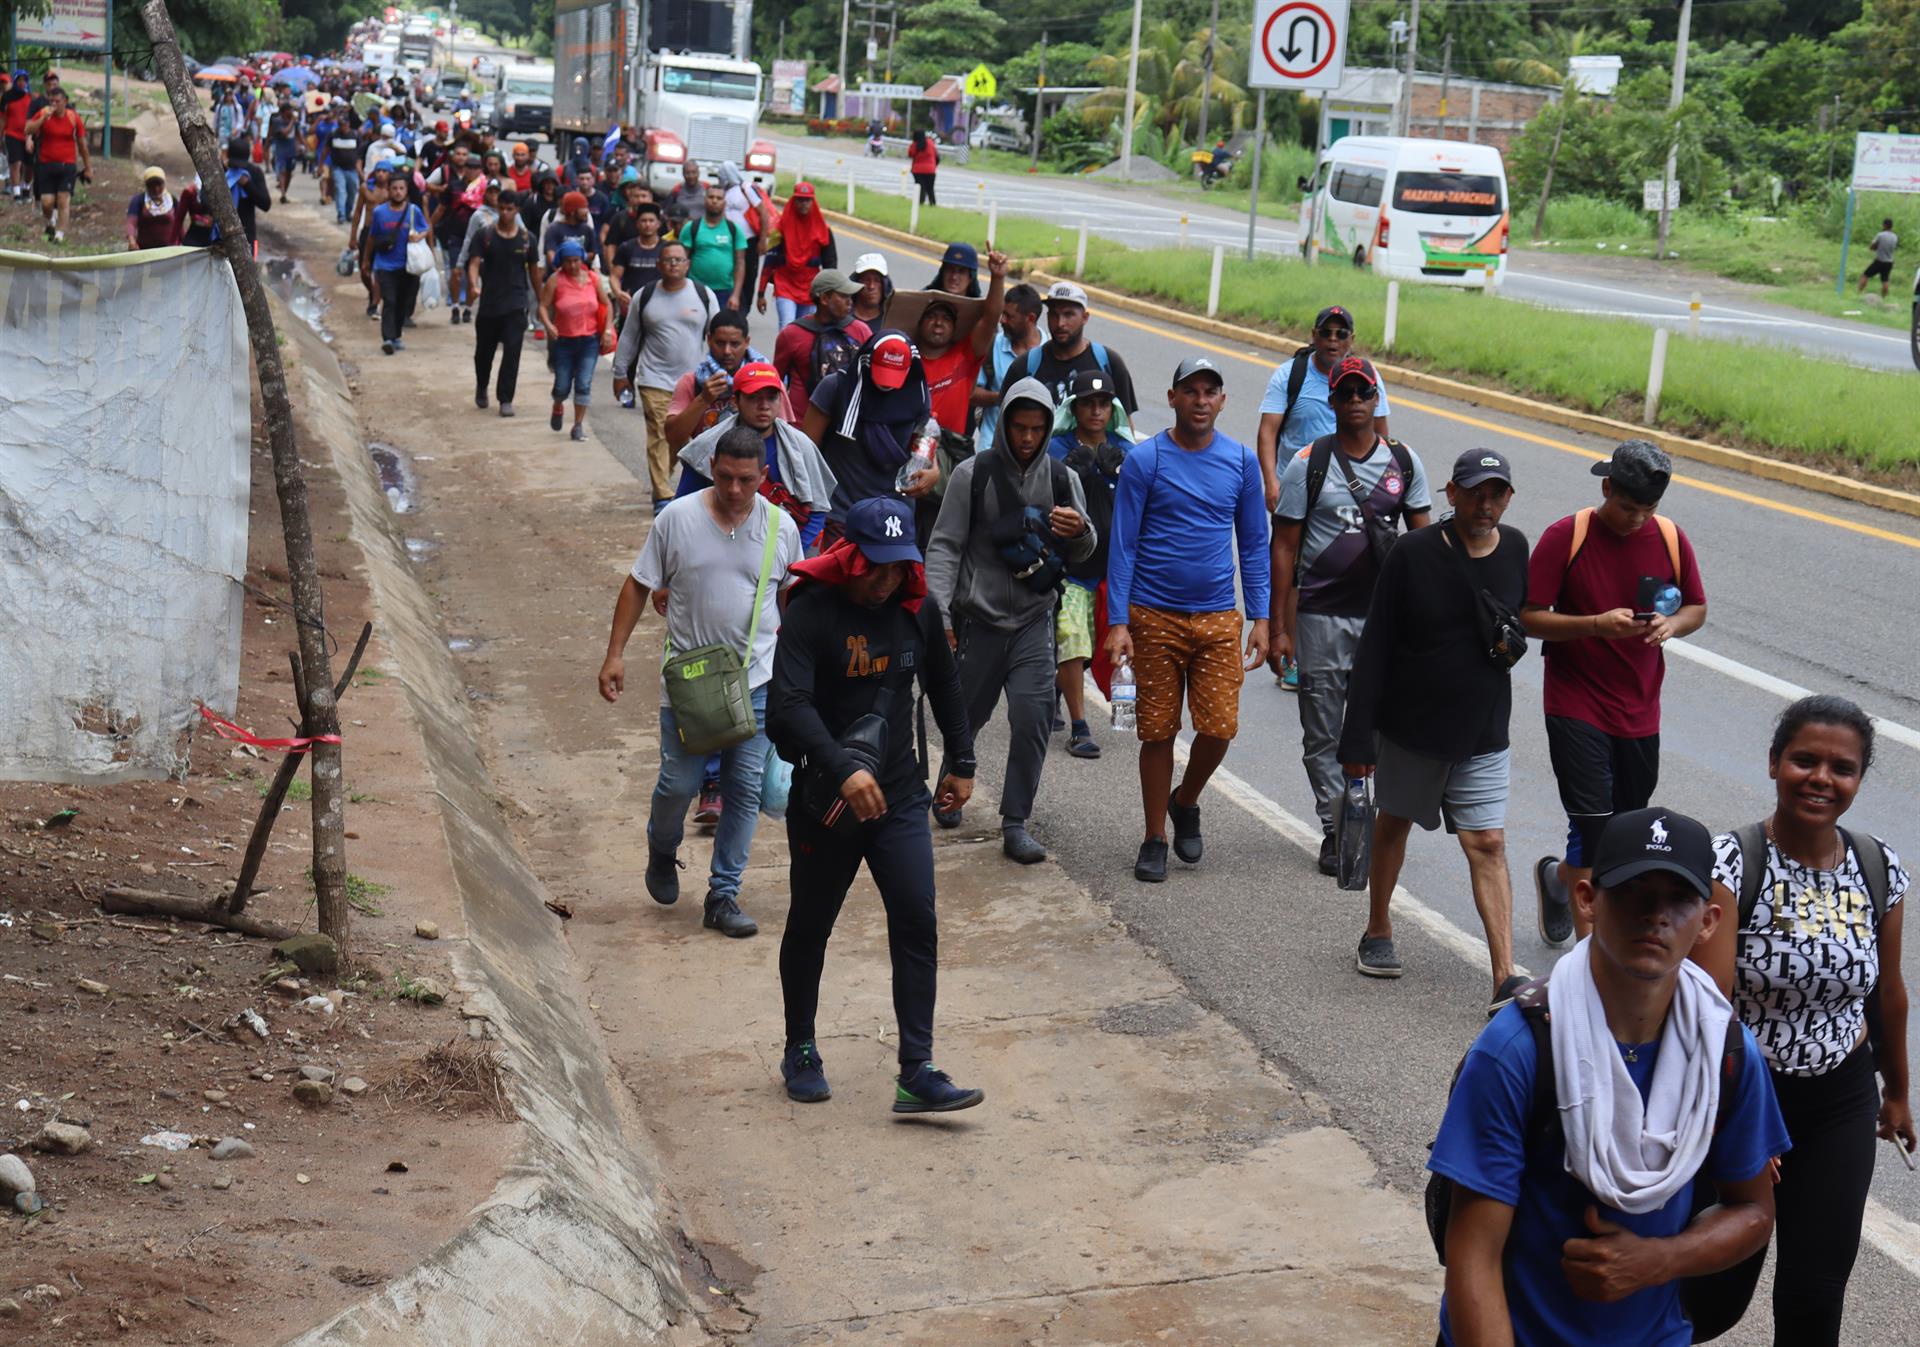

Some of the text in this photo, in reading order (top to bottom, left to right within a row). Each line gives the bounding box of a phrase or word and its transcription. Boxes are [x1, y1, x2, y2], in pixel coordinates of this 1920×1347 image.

[875, 86, 922, 95] RETORNO
[885, 515, 903, 537] NY
[682, 660, 709, 680] CAT
[1645, 844, 1672, 852] POLO
[1773, 883, 1873, 939] LOVE
